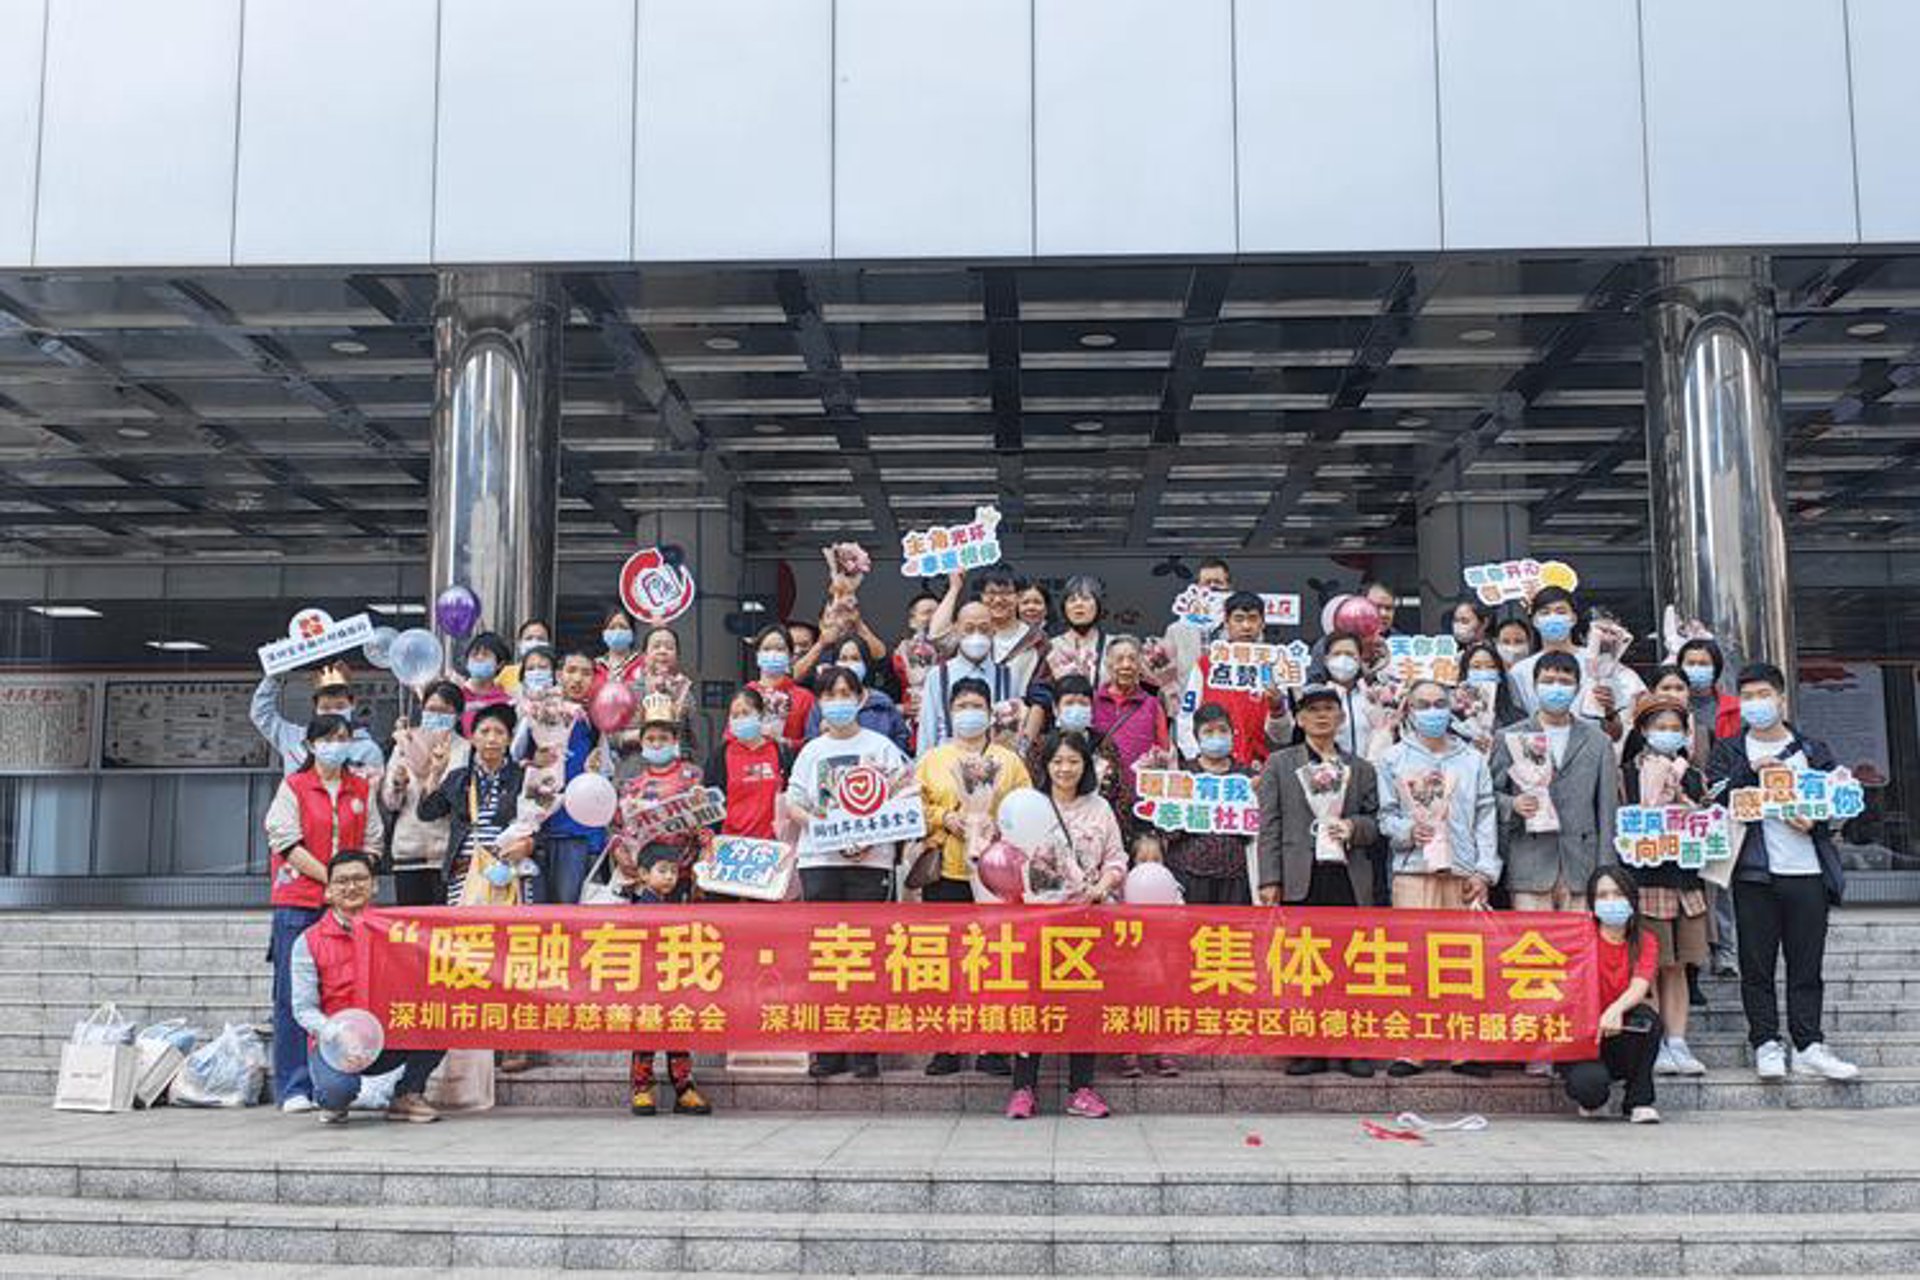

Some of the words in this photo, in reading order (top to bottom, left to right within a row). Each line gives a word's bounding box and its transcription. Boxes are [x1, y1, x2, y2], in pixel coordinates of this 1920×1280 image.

[906, 523, 985, 557] 主角光环
[1182, 691, 1197, 712] 9
[1733, 768, 1862, 818] 感恩有你
[1157, 801, 1259, 831] 幸福社区
[1621, 808, 1710, 838] 逆风而行
[1634, 832, 1729, 863] 向阳而生
[388, 1002, 727, 1033] 深圳市同佳岸慈善基金会
[760, 1003, 1068, 1033] 深圳宝安融兴村镇银行
[1101, 1004, 1573, 1043] 深圳市宝安区尚德社会工作服务社
